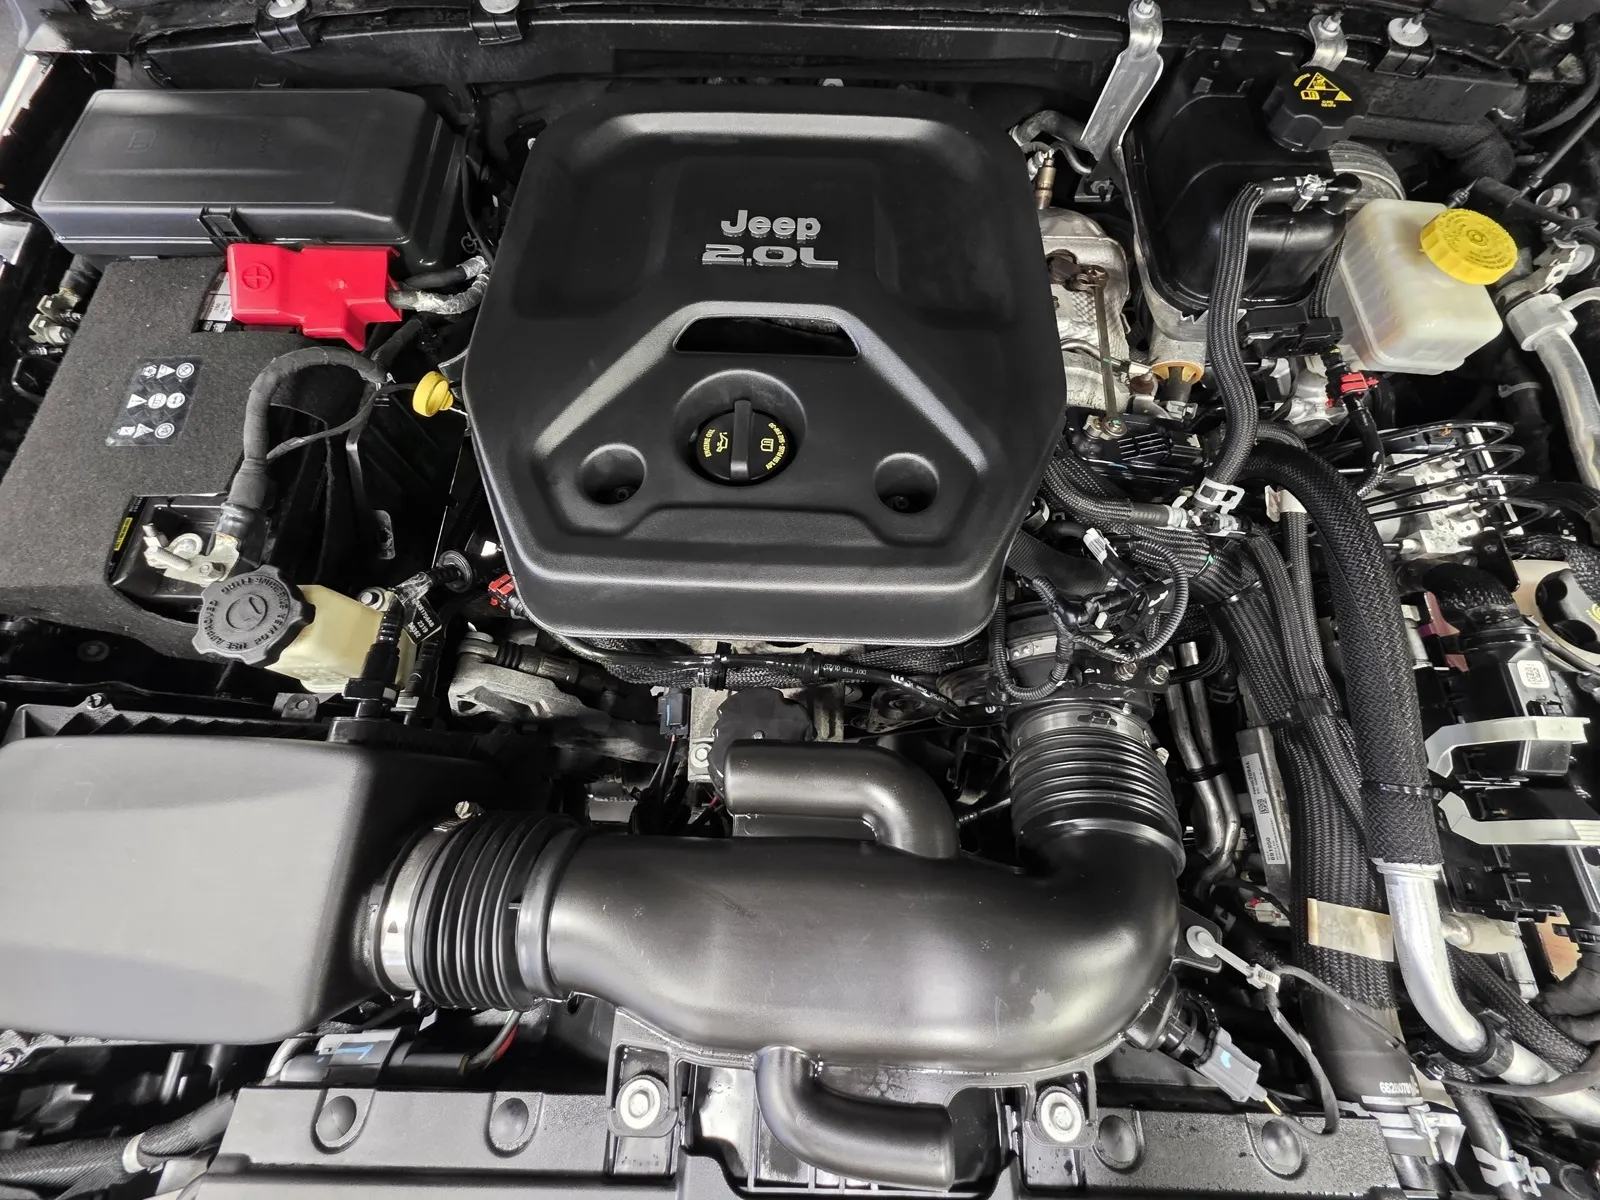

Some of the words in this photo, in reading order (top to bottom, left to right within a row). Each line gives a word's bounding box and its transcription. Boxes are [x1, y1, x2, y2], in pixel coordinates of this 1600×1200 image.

[720, 209, 821, 244] Jeep
[702, 243, 839, 269] 2.0L
[705, 429, 716, 438] OIL
[703, 437, 712, 458] ENGINE
[203, 599, 226, 646] APPROVED
[226, 642, 248, 650] USE
